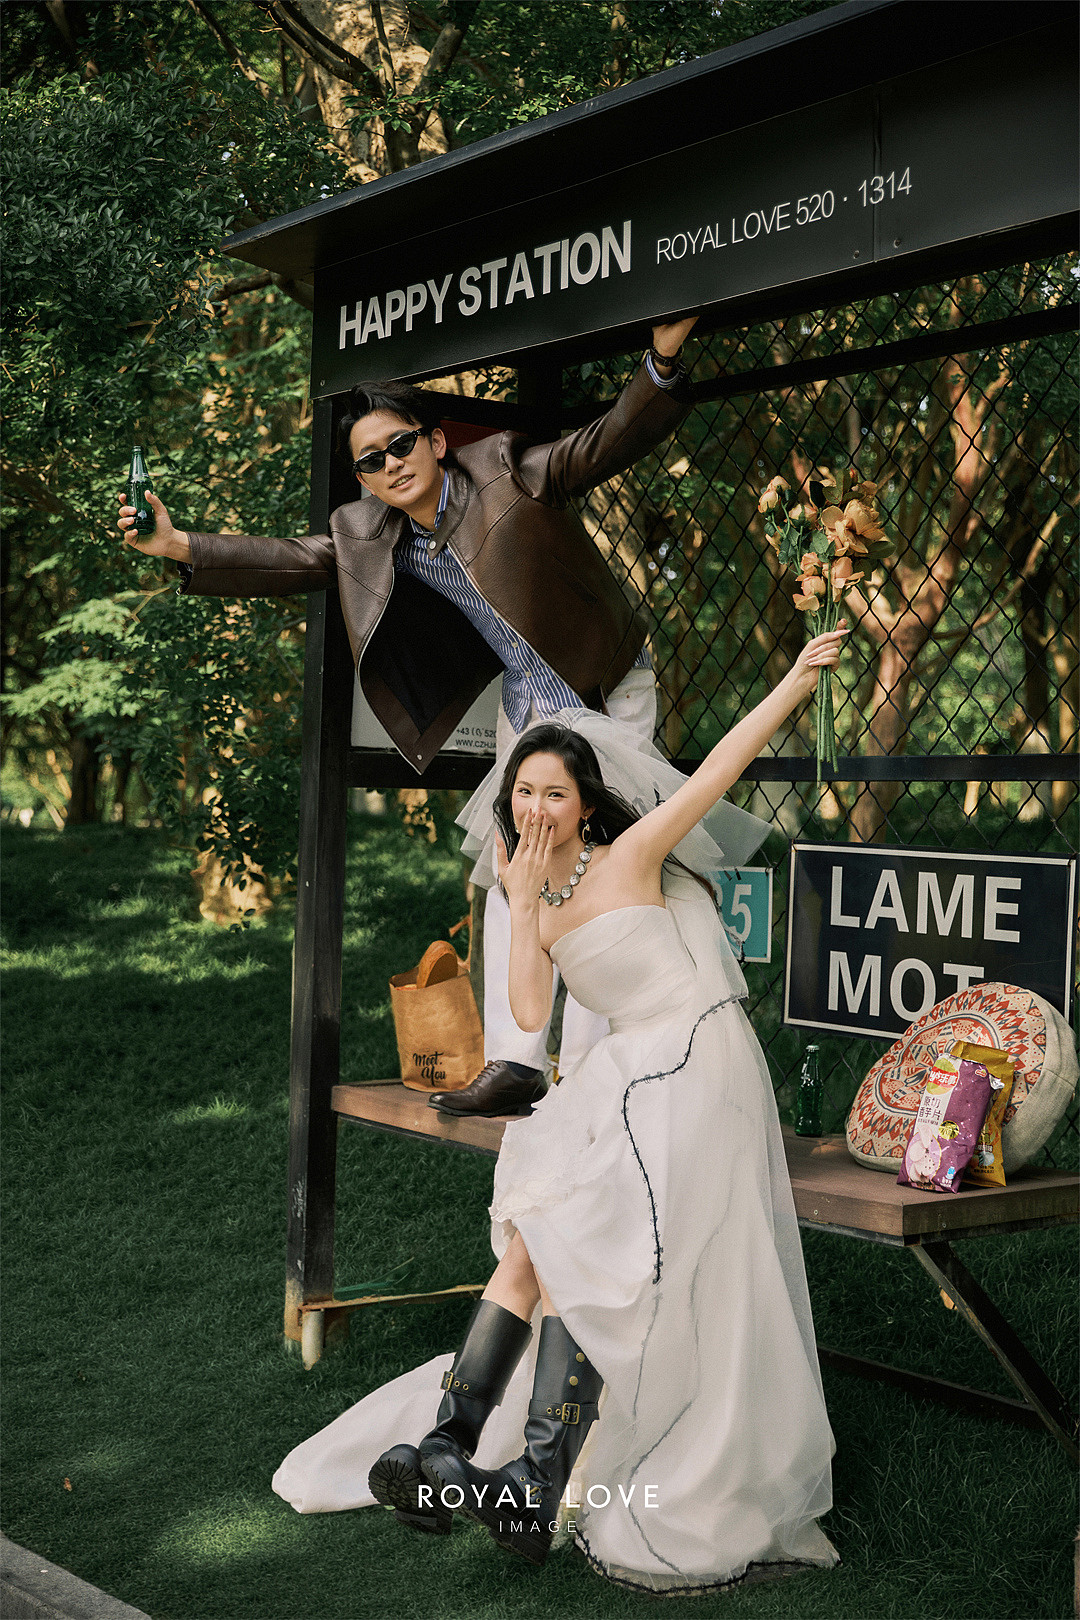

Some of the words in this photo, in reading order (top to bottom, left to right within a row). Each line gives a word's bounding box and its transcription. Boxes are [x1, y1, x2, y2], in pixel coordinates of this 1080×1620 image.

[656, 223, 727, 265] ROYAL
[731, 202, 791, 244] LOVE
[796, 190, 834, 226] 520
[858, 166, 912, 207] 1314
[338, 273, 453, 351] HAPPY
[457, 219, 632, 317] STATION
[830, 865, 1022, 943] LAME
[827, 950, 985, 1023] MOT
